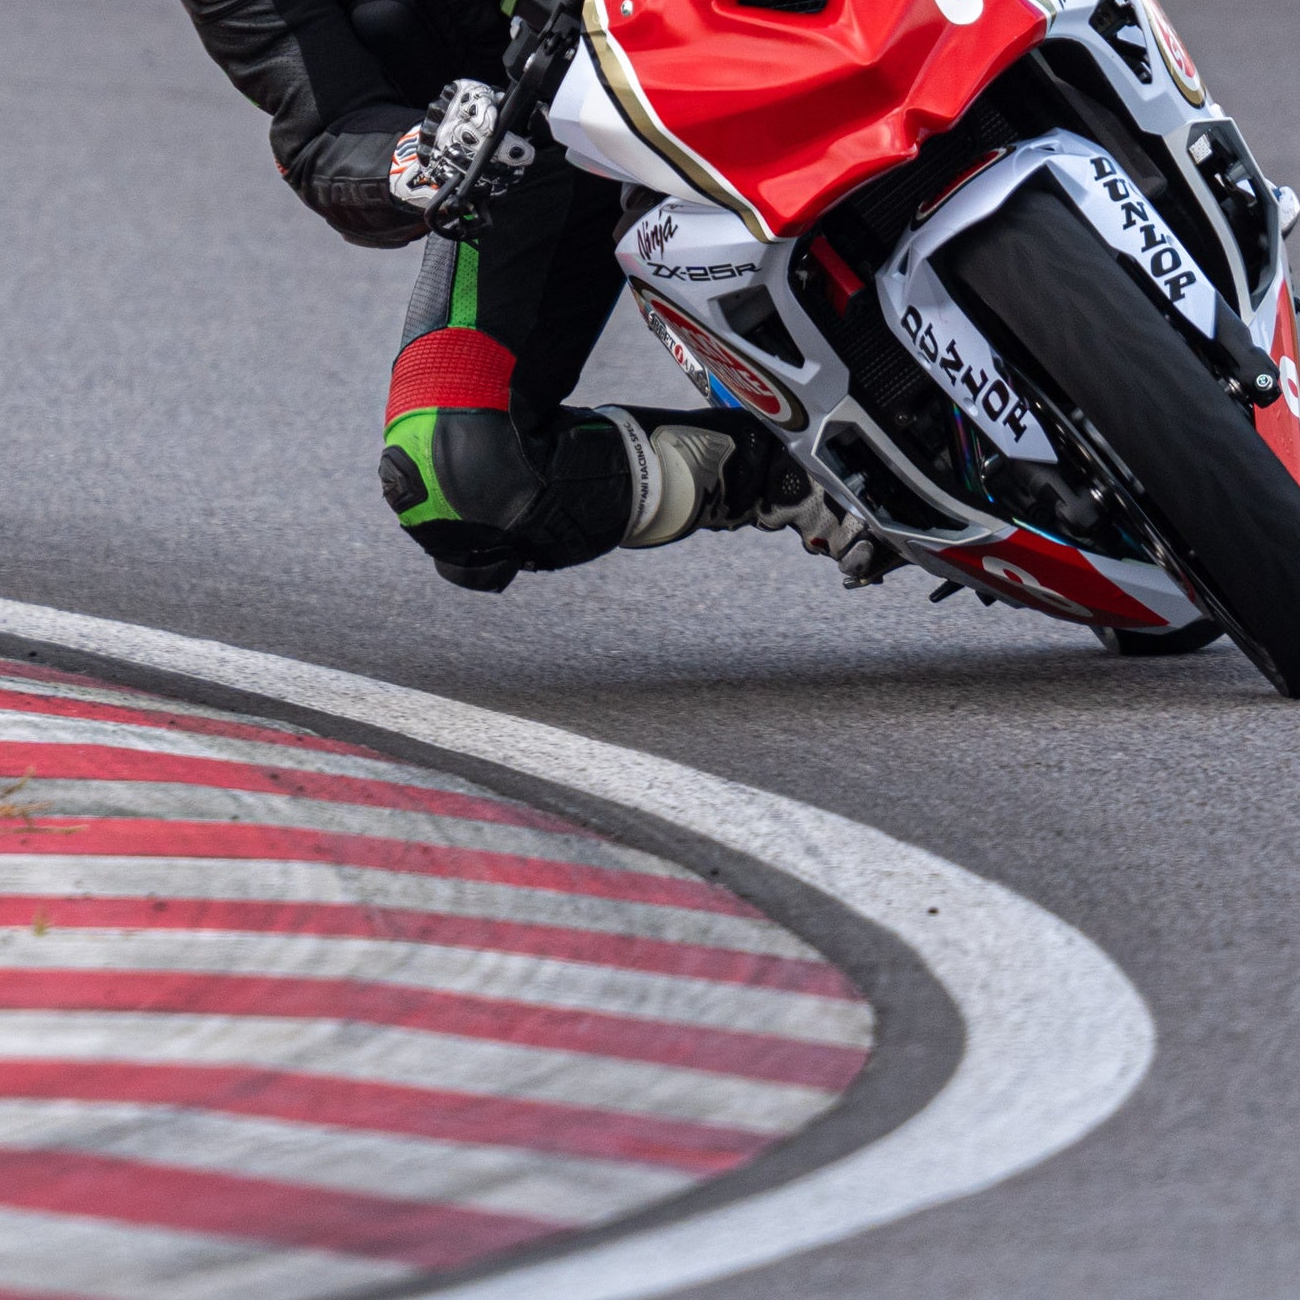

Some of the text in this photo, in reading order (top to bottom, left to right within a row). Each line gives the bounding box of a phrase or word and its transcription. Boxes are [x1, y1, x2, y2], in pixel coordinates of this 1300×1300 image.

[636, 208, 679, 261] Ninja
[1090, 156, 1196, 303] DUNLOP
[646, 261, 763, 282] ZX-25R
[901, 304, 1030, 443] DUNLOP
[623, 421, 639, 442] SPEC
[634, 443, 649, 480] RACING
